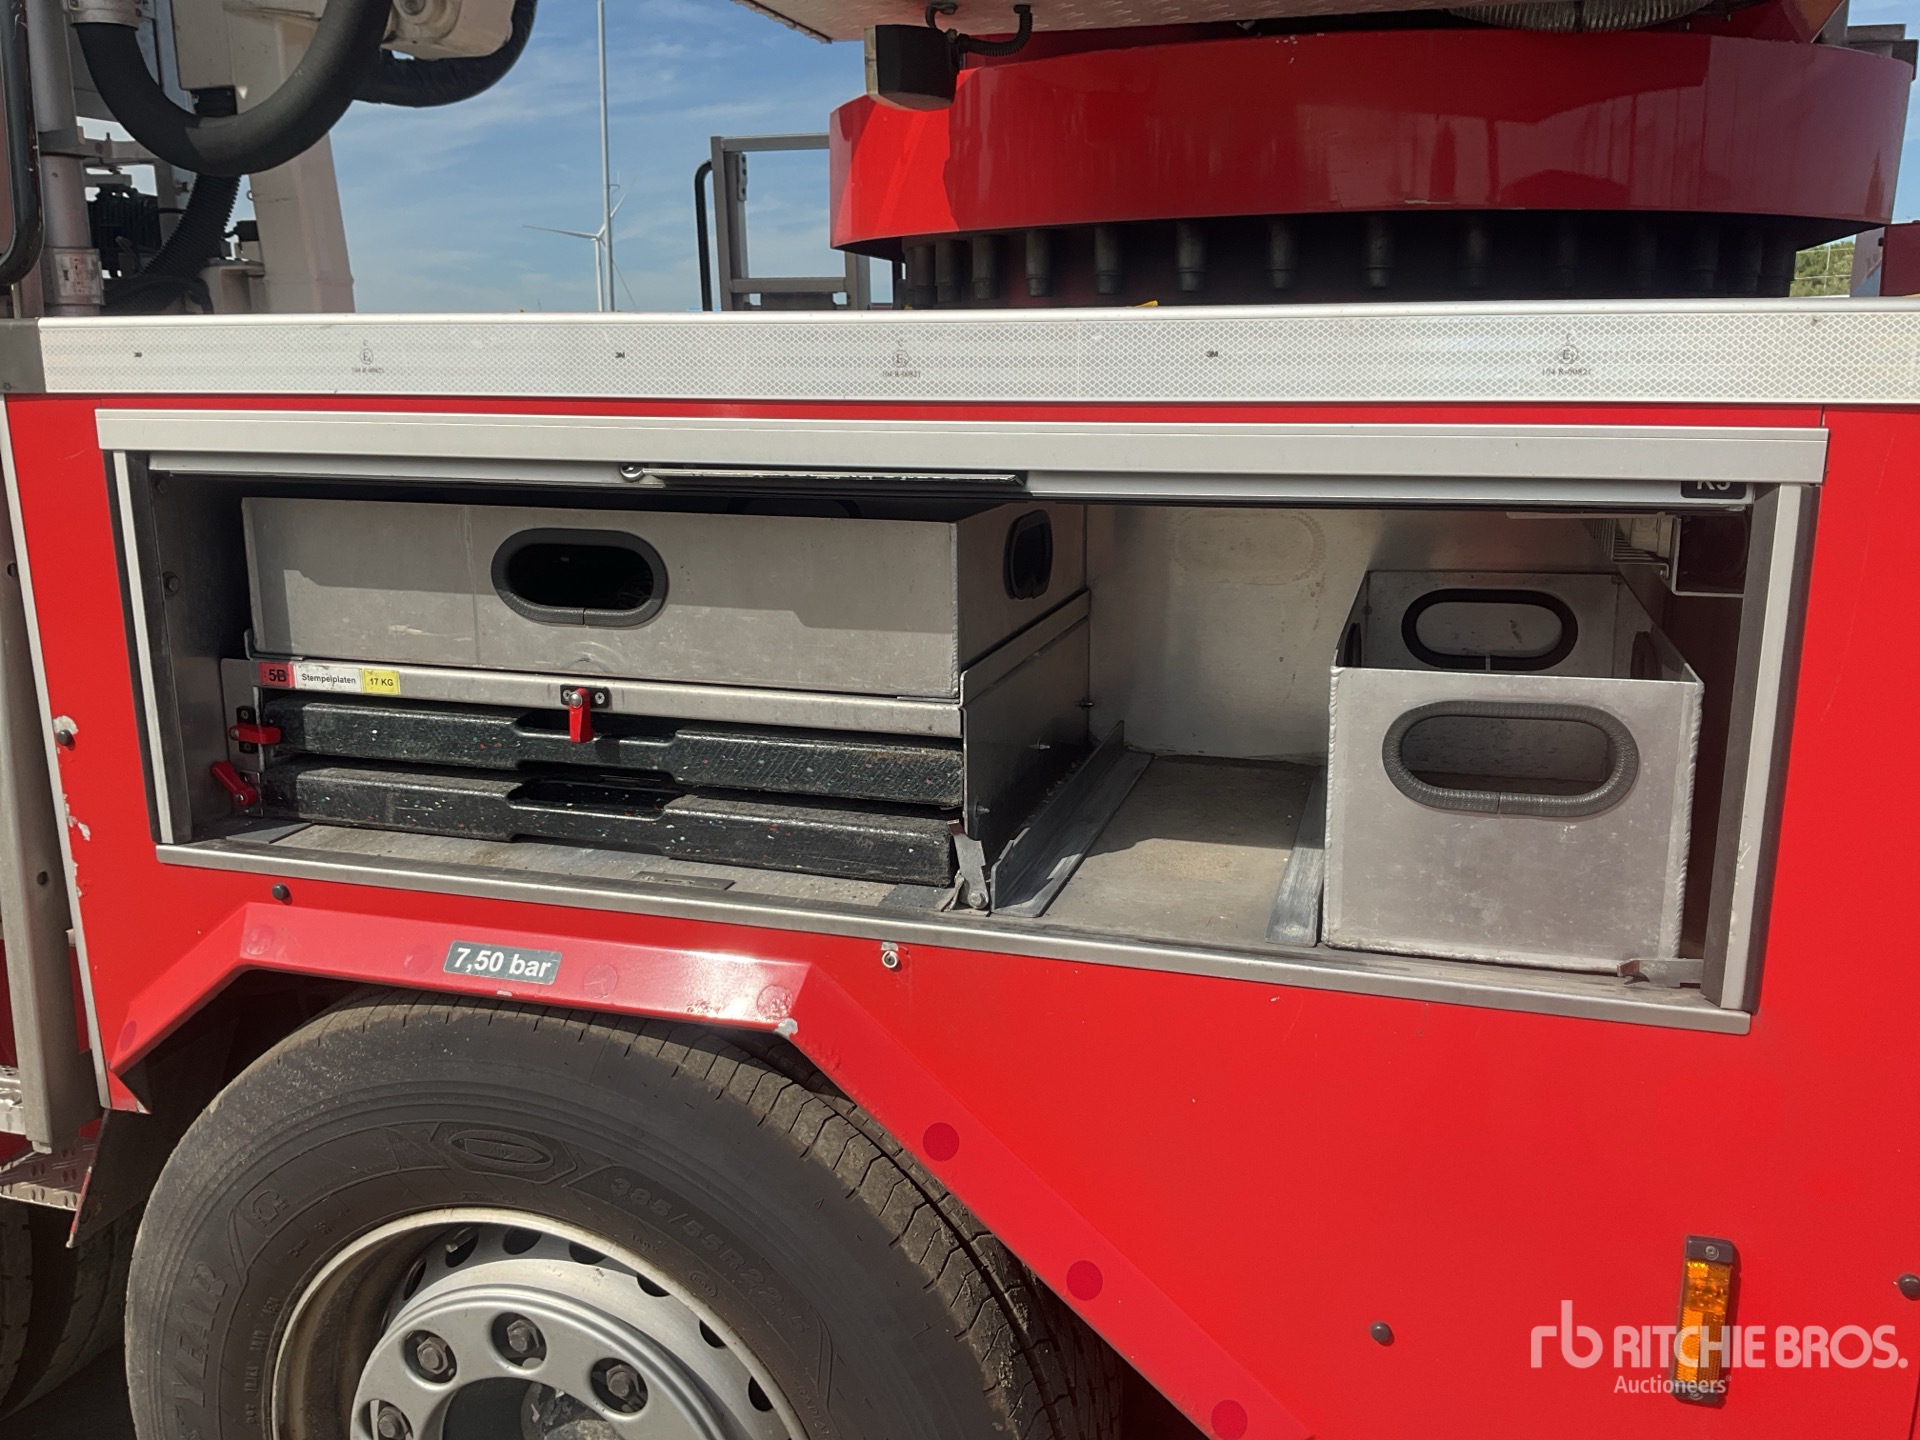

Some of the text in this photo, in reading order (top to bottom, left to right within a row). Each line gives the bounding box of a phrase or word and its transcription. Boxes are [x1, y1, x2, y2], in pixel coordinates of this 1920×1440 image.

[615, 351, 626, 359] 3M
[1206, 350, 1219, 358] 3M
[268, 668, 394, 687] 5B Stempelplaten 17 KG
[454, 947, 552, 978] 7,50 bar
